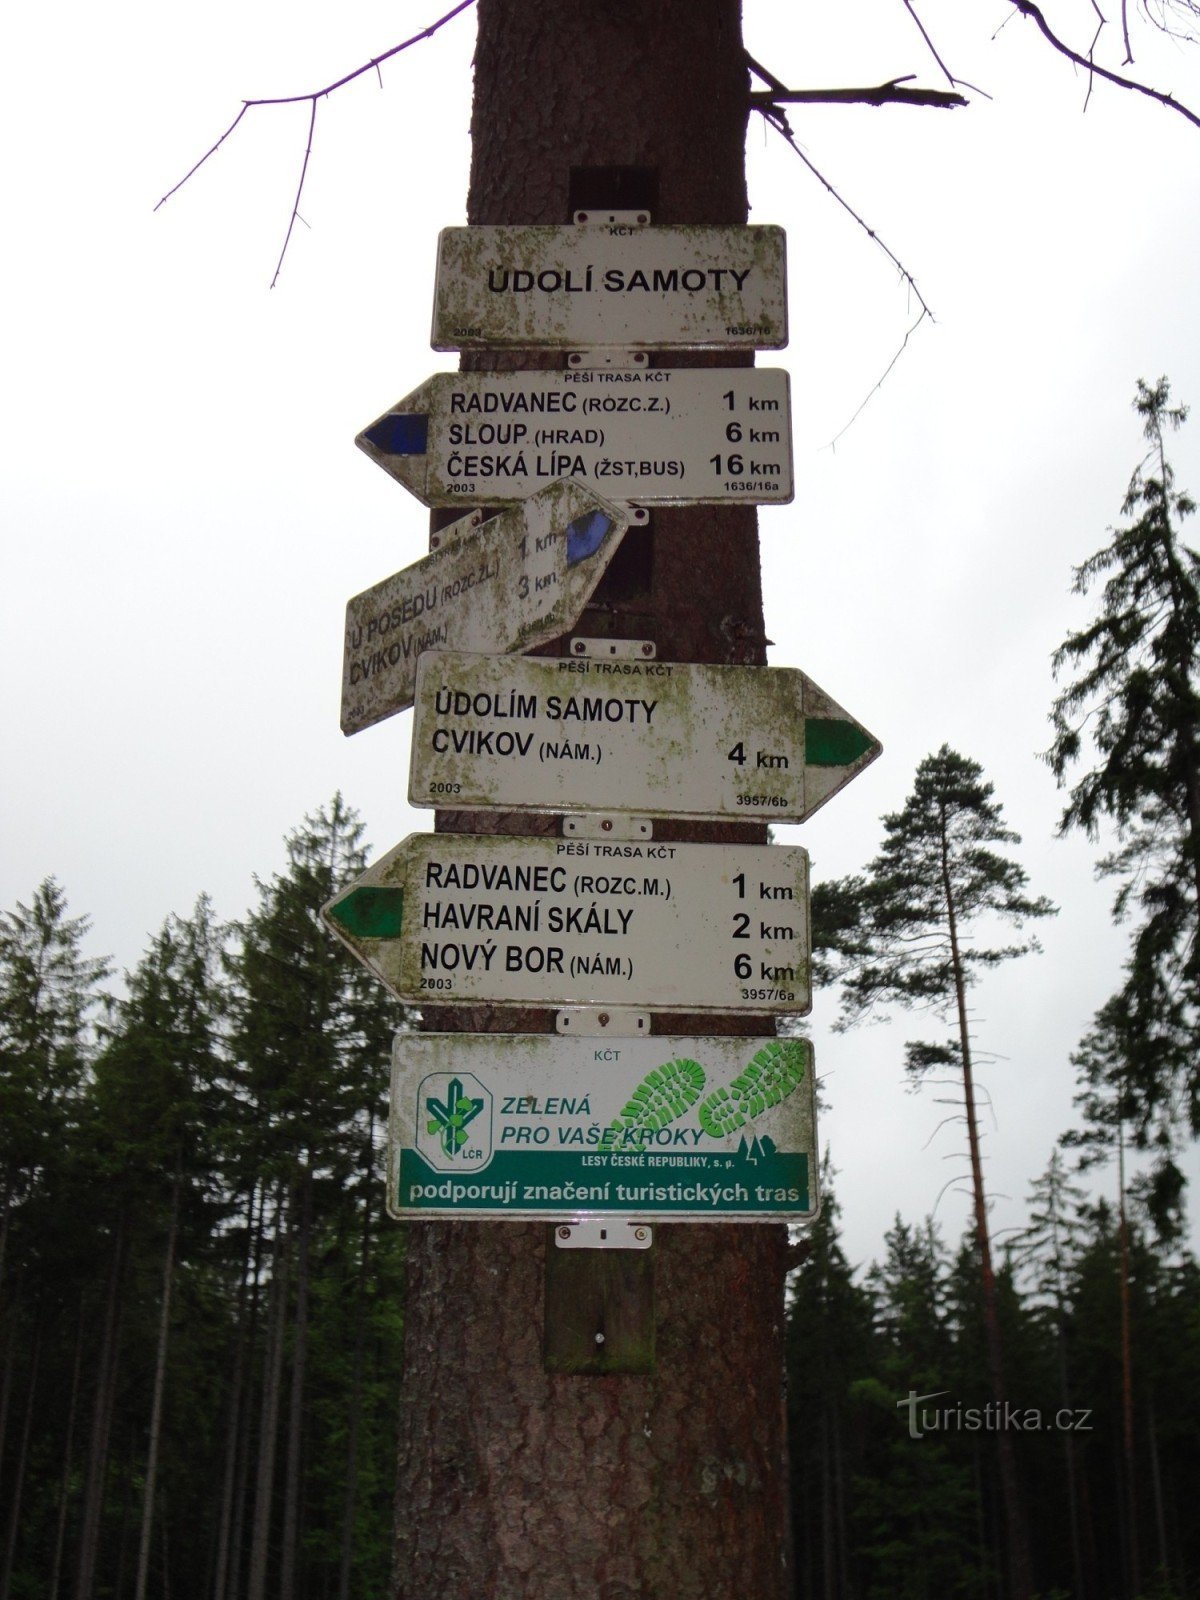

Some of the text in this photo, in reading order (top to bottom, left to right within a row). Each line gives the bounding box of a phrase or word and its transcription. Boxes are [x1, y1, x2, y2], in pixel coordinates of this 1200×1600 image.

[488, 265, 751, 293] ÚDOLÍ SAMOTY
[564, 371, 671, 383] PĚŠÍ TRASA KČT
[451, 390, 779, 415] RADVANEC (ROZC.Z.) 1 km
[448, 422, 780, 448] SLOUP (HRAD) 6 km
[446, 451, 781, 479] ČESKÁ LÍPA (ŽST,BUS) 16 km
[446, 483, 476, 493] 2003
[724, 482, 779, 491] 1636/16a
[367, 586, 437, 643] POSEDU
[518, 536, 526, 560] 1
[536, 532, 557, 553] km
[349, 634, 412, 686] CVIKOV
[518, 575, 530, 600] 3
[536, 571, 557, 592] km
[558, 661, 674, 677] PĚŠÍ TRASA KČT
[435, 686, 658, 724] ÚDOLÍM SAMOTY
[432, 728, 789, 769] CVIKOV (NÁM.) 4 km
[429, 782, 461, 794] 2003
[736, 795, 789, 808] 3957/6b
[556, 843, 677, 859] PĚŠÍ TRASA KČT
[425, 862, 793, 901] RADVANEC (ROZC.M.) 1 km
[423, 900, 793, 940] HAVRANÍ SKÁLY 2 km
[420, 939, 794, 981] NOVÝ BOR (NÁM.) 6 km
[419, 978, 453, 990] 2003
[741, 988, 795, 1001] 3957/6a
[594, 1048, 621, 1062] KČT
[500, 1093, 591, 1115] ZELENÁ
[500, 1122, 706, 1146] PRO VAŠE KROKY
[581, 1156, 608, 1167] LESY
[611, 1153, 645, 1167] ČESKÉ
[648, 1156, 711, 1169] REPUBLIKY,
[410, 1181, 800, 1206] podporují značení turistických tras
